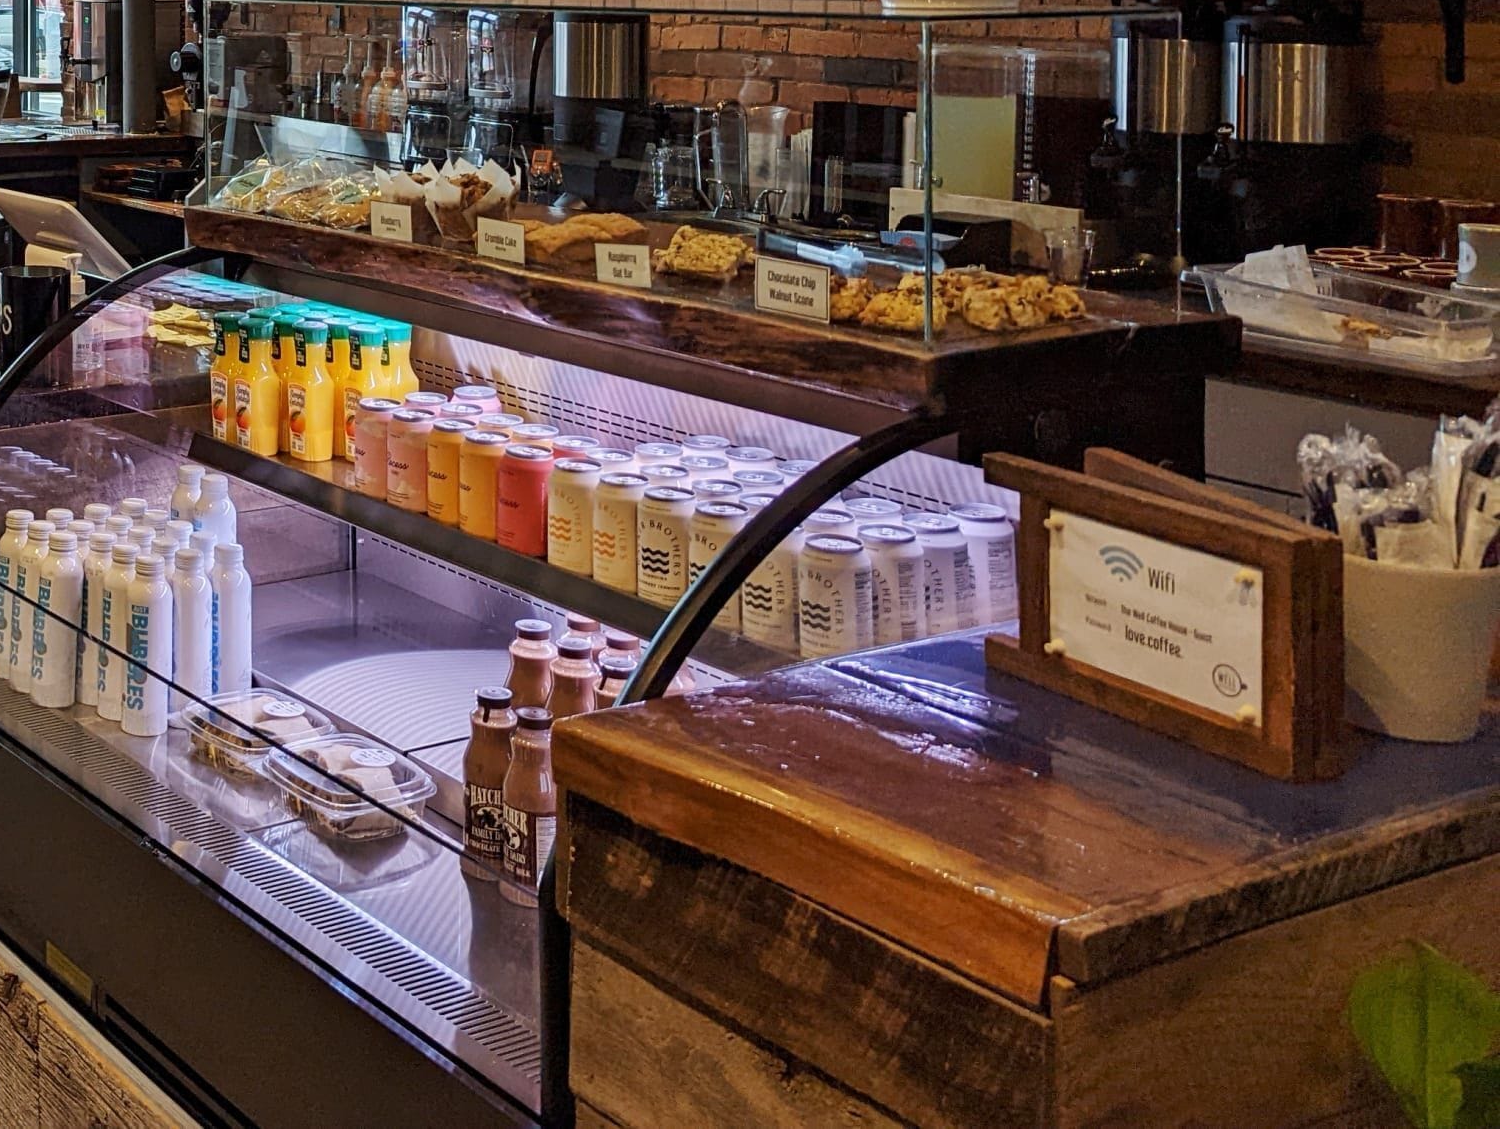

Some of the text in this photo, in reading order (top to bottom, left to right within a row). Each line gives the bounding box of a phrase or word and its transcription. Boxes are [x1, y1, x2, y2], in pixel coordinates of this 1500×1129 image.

[768, 270, 816, 290] Chocolate Chip
[770, 288, 814, 307] Walnut Scone
[650, 520, 682, 577] BROTHERS
[1148, 567, 1176, 595] Wifi
[1146, 611, 1167, 629] Coffee
[1217, 671, 1237, 693] WELL
[470, 784, 501, 807] HATCH
